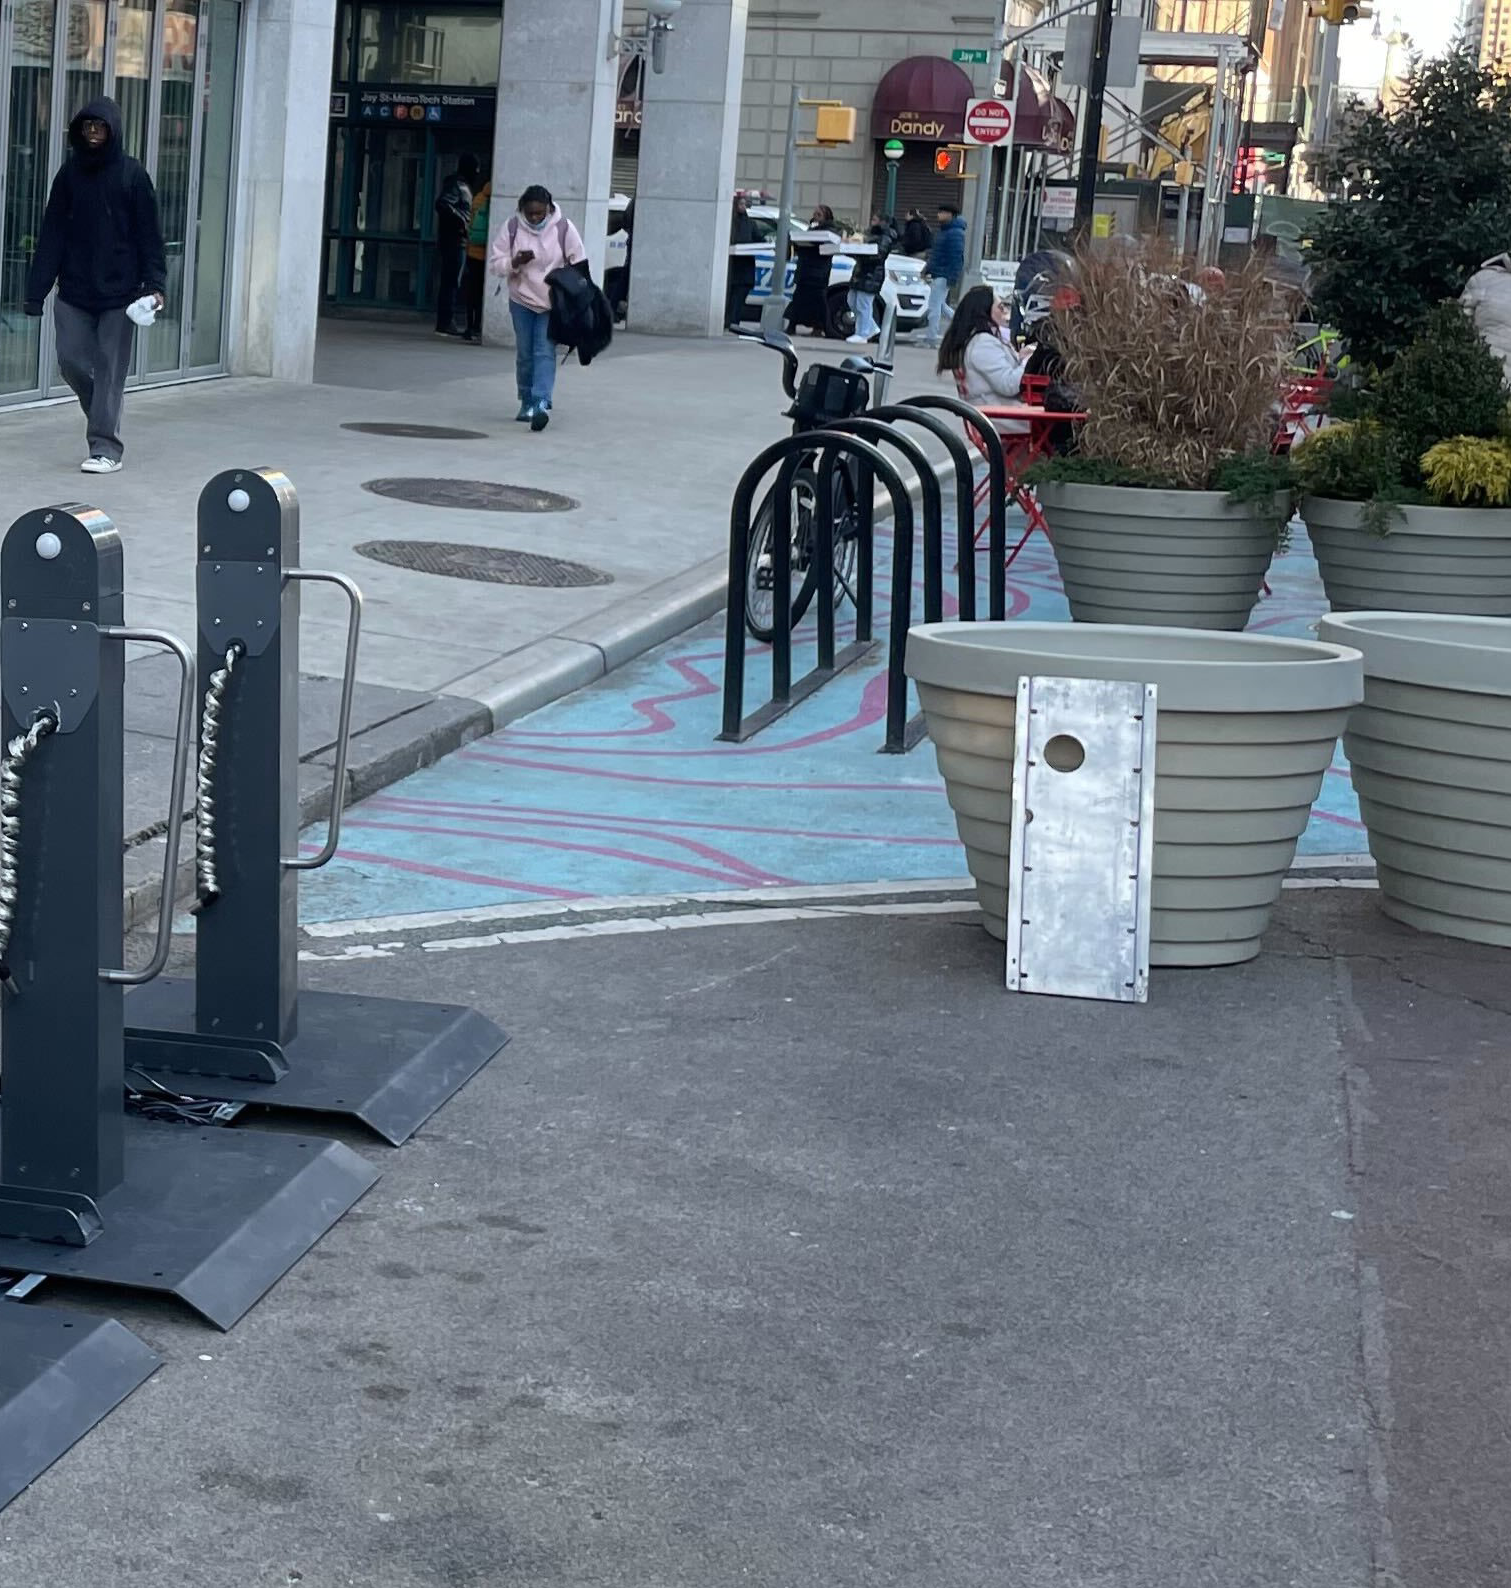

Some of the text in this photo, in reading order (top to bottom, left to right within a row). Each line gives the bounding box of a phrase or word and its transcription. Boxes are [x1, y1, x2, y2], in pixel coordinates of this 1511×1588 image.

[959, 51, 974, 63] Jay
[361, 92, 378, 103] Jay
[442, 95, 475, 106] Station
[363, 106, 372, 116] A
[380, 106, 389, 116] C
[975, 108, 1005, 117] DO NOT
[891, 119, 945, 138] Dandy
[975, 128, 1001, 136] ENTER
